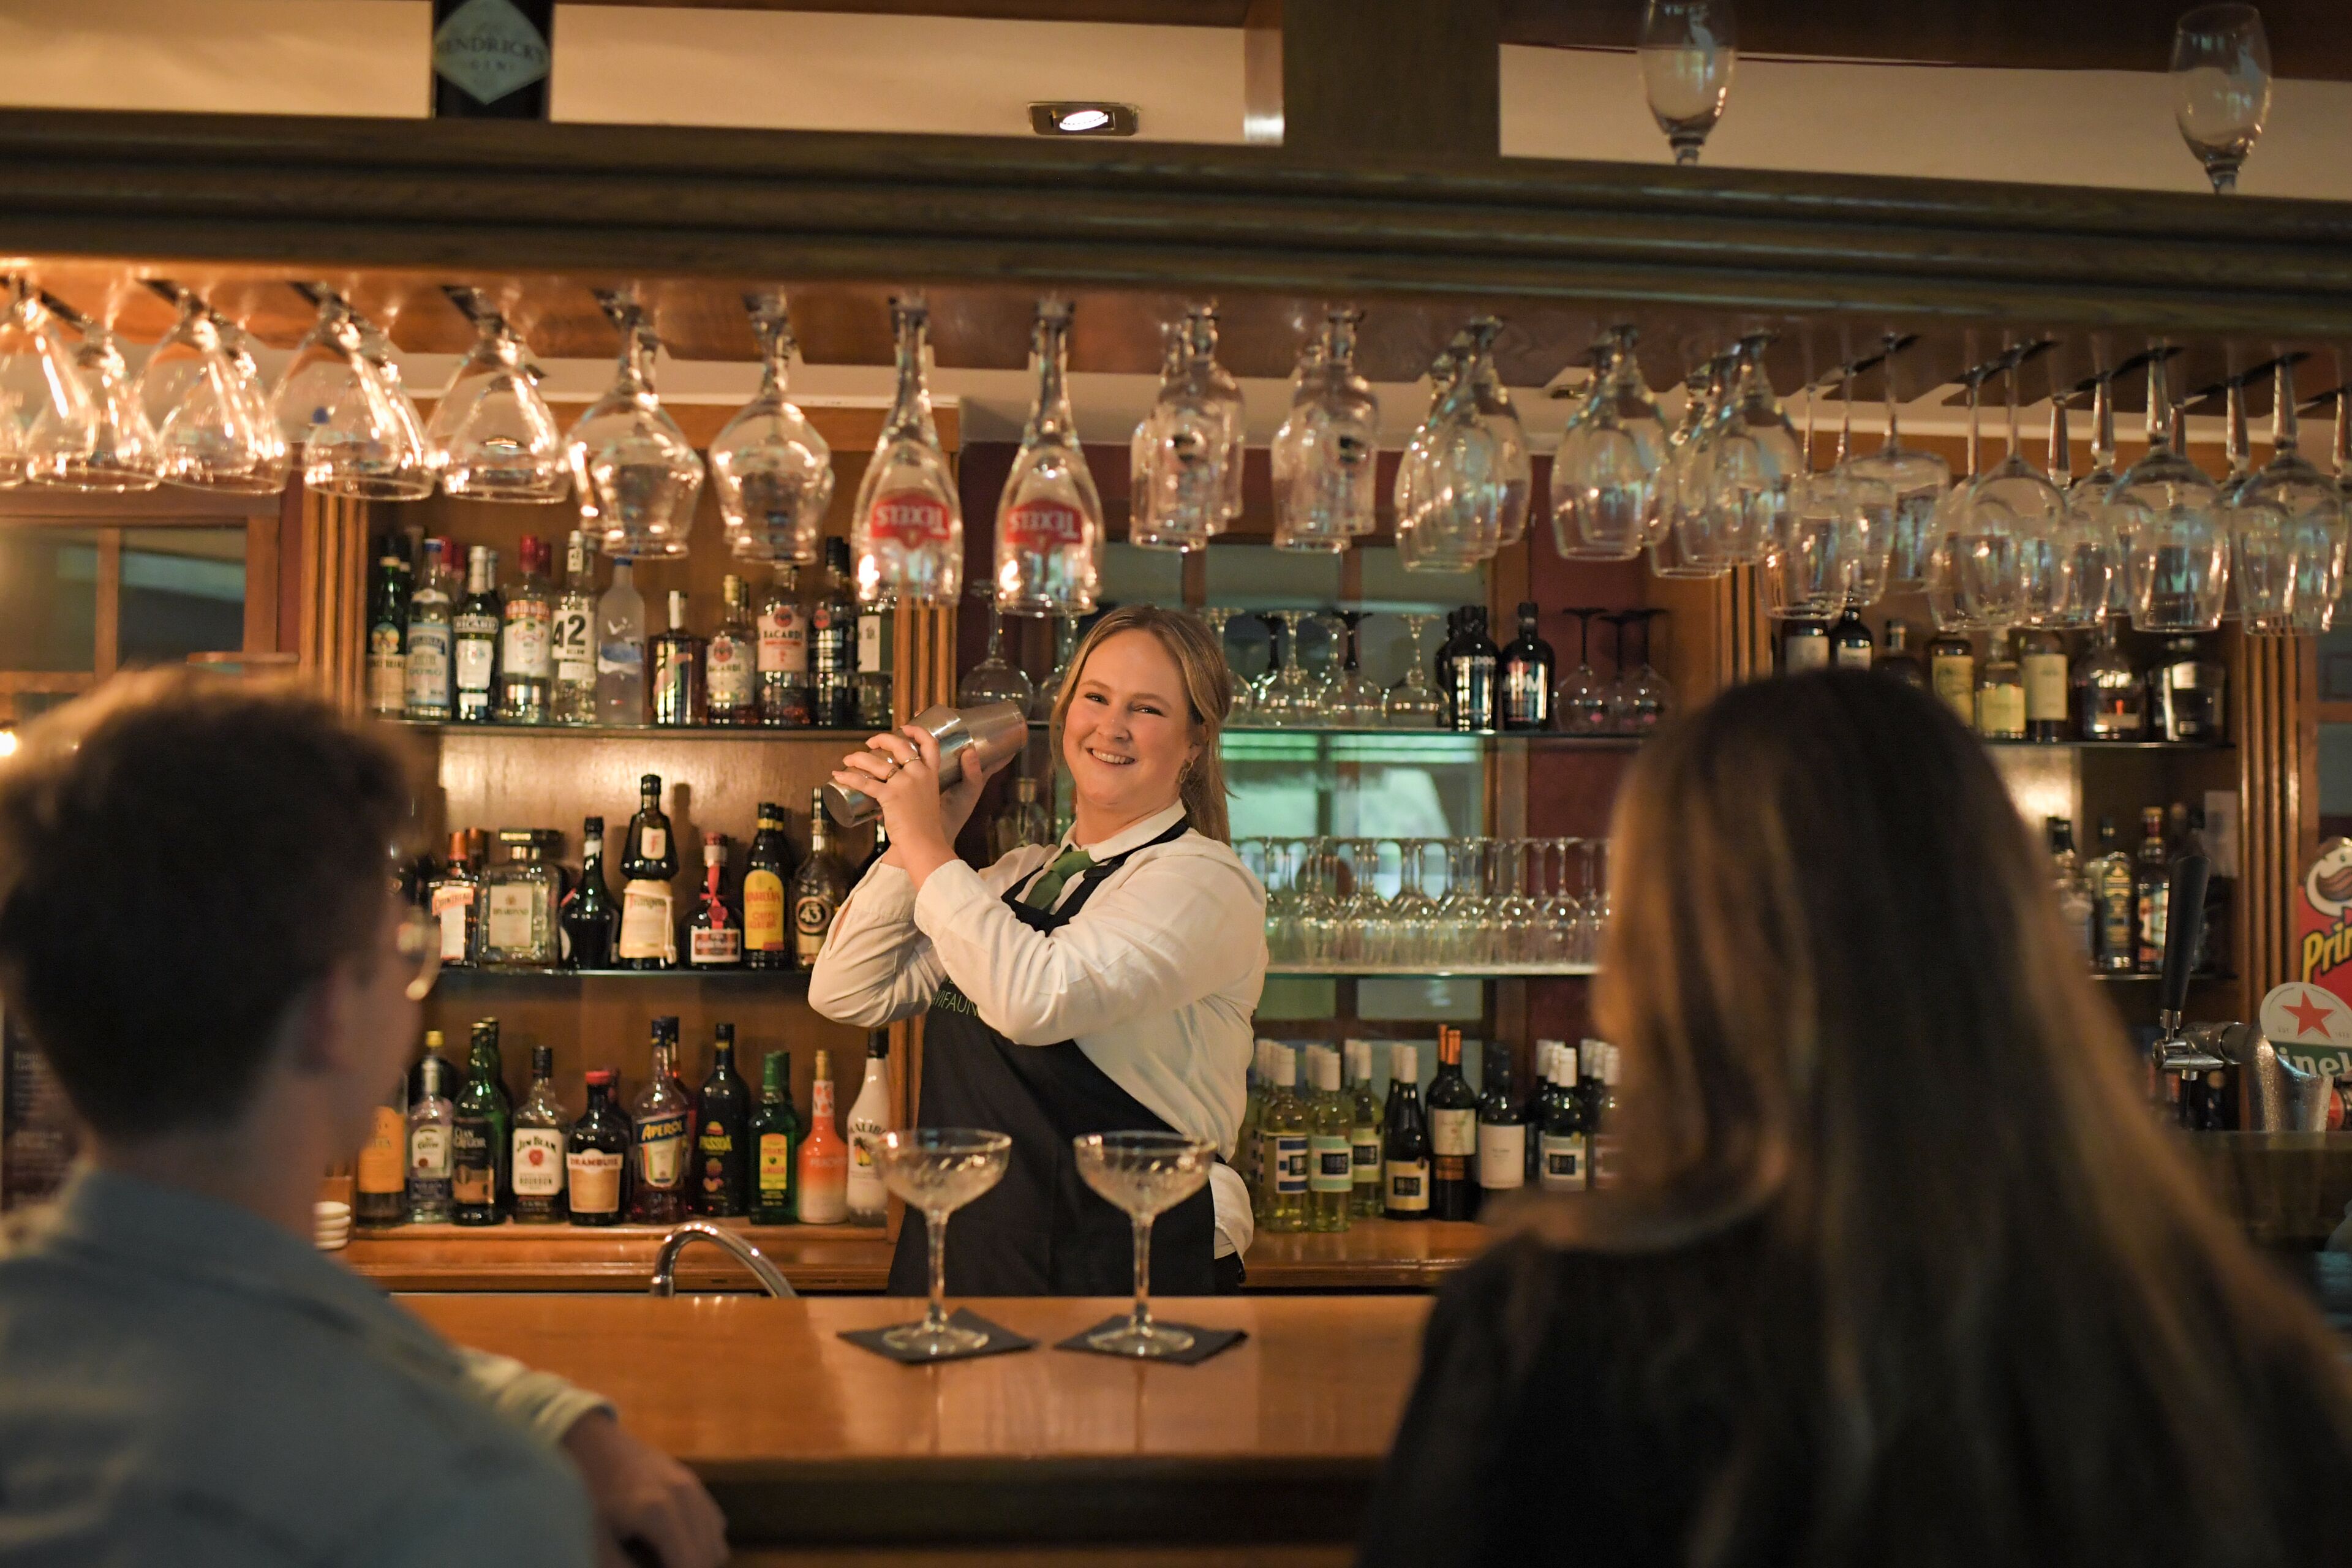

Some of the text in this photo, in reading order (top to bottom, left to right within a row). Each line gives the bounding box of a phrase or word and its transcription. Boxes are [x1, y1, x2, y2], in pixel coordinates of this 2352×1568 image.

[553, 614, 586, 648] 42
[800, 904, 822, 923] 43
[641, 1120, 682, 1141] APEROL
